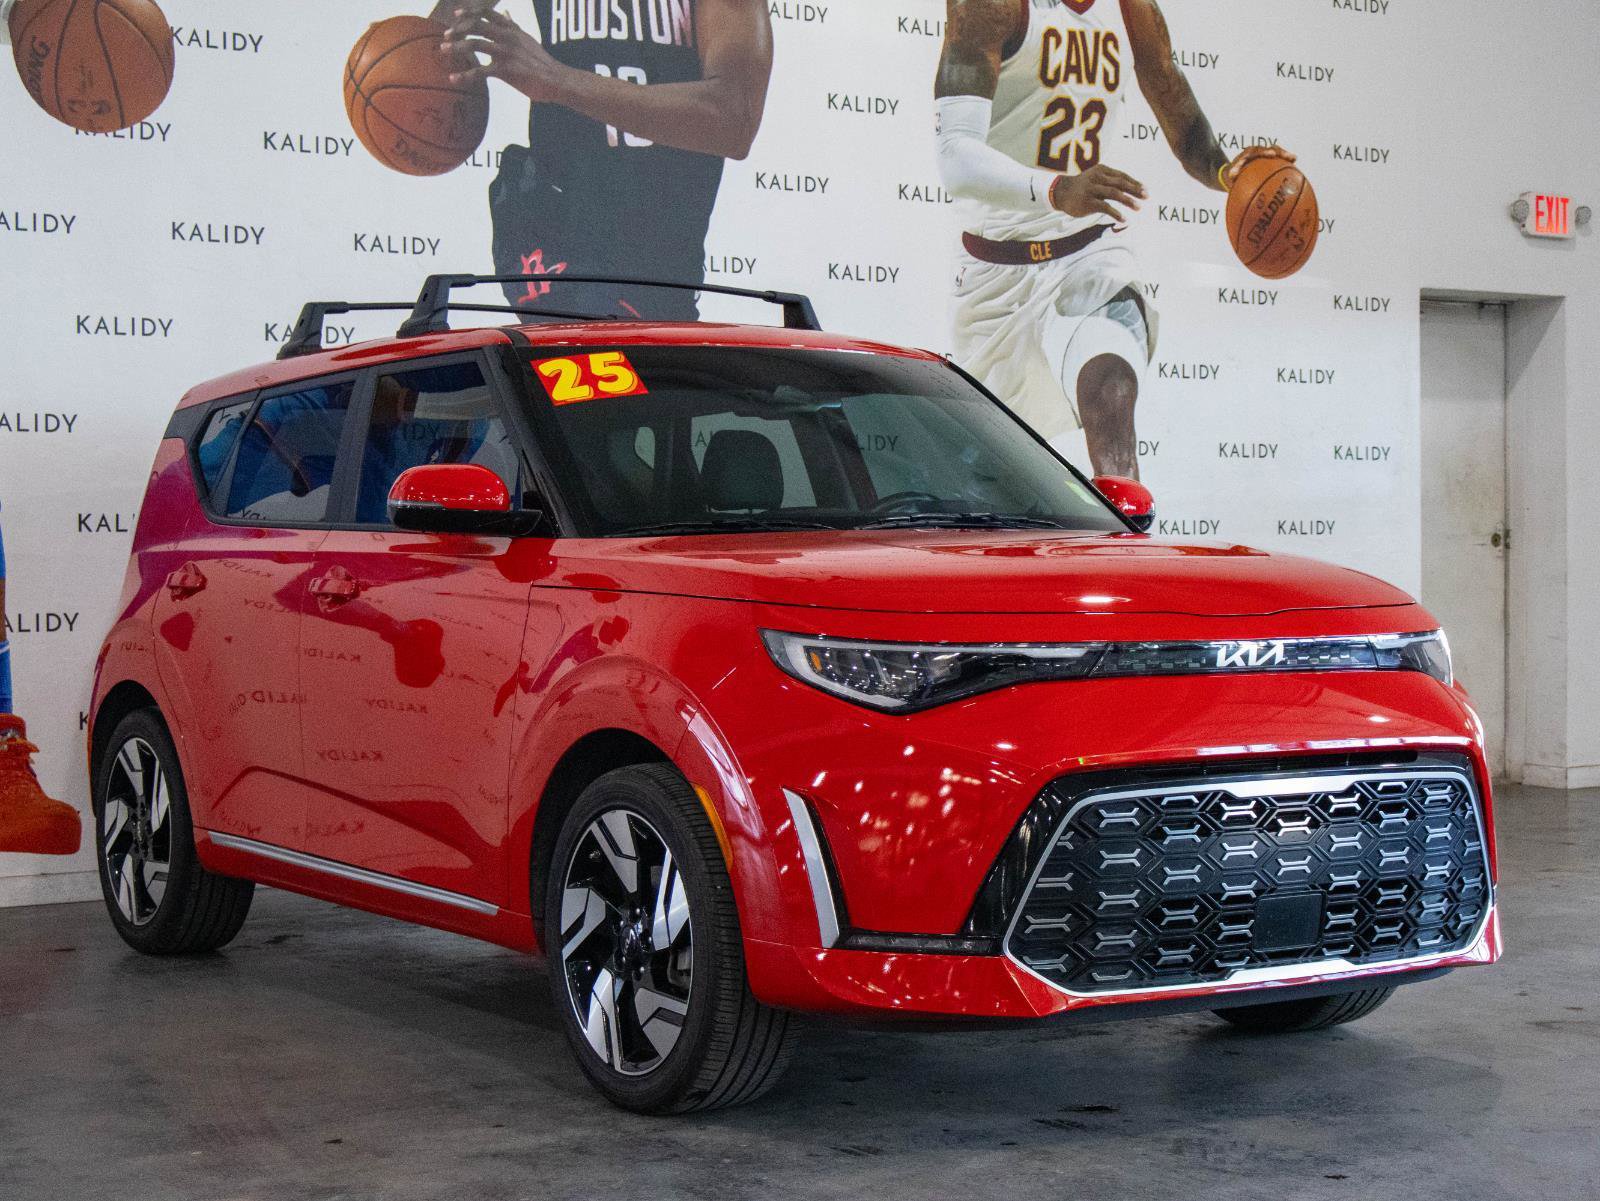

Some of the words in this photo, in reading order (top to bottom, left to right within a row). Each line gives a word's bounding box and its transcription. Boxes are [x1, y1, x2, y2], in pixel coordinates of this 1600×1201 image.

[769, 2, 829, 24] ALIDY
[551, 0, 693, 48] HOUSTON
[898, 16, 947, 37] KALI
[171, 26, 263, 53] KALIDY
[1039, 26, 1120, 93] CAVS
[1171, 50, 1220, 70] ALIDY
[1276, 61, 1335, 83] KALIDY
[827, 92, 899, 116] KALIDY
[1037, 95, 1107, 173] 23
[1123, 123, 1160, 142] IDY
[263, 131, 355, 157] KALIDY
[1333, 144, 1390, 164] KALIDY
[755, 171, 829, 194] KALIDY
[898, 183, 953, 204] KALI
[0, 210, 76, 234] ALIDY
[1158, 205, 1220, 225] KALIDY
[1535, 195, 1569, 235] EXIT
[171, 221, 265, 245] KALIDY
[354, 232, 441, 256] KALIDY
[1029, 240, 1052, 261] CLE
[703, 255, 757, 275] LIDY
[828, 263, 900, 284] KALIDY
[1218, 287, 1278, 306] KALIDY
[1333, 294, 1390, 313] KALIDY
[76, 314, 173, 338] KALIDY
[264, 322, 355, 344] KADY
[538, 351, 638, 402] 25
[1158, 362, 1220, 380] KALIDY
[1277, 367, 1335, 385] KALIDY
[0, 412, 77, 433] ALIDY
[1219, 442, 1278, 459] KALIDY
[1334, 445, 1391, 462] KALIDY
[78, 513, 135, 533] KAL
[1158, 519, 1220, 536] KALIDY
[1277, 519, 1336, 536] KALIDY
[4, 612, 79, 633] ALIDY
